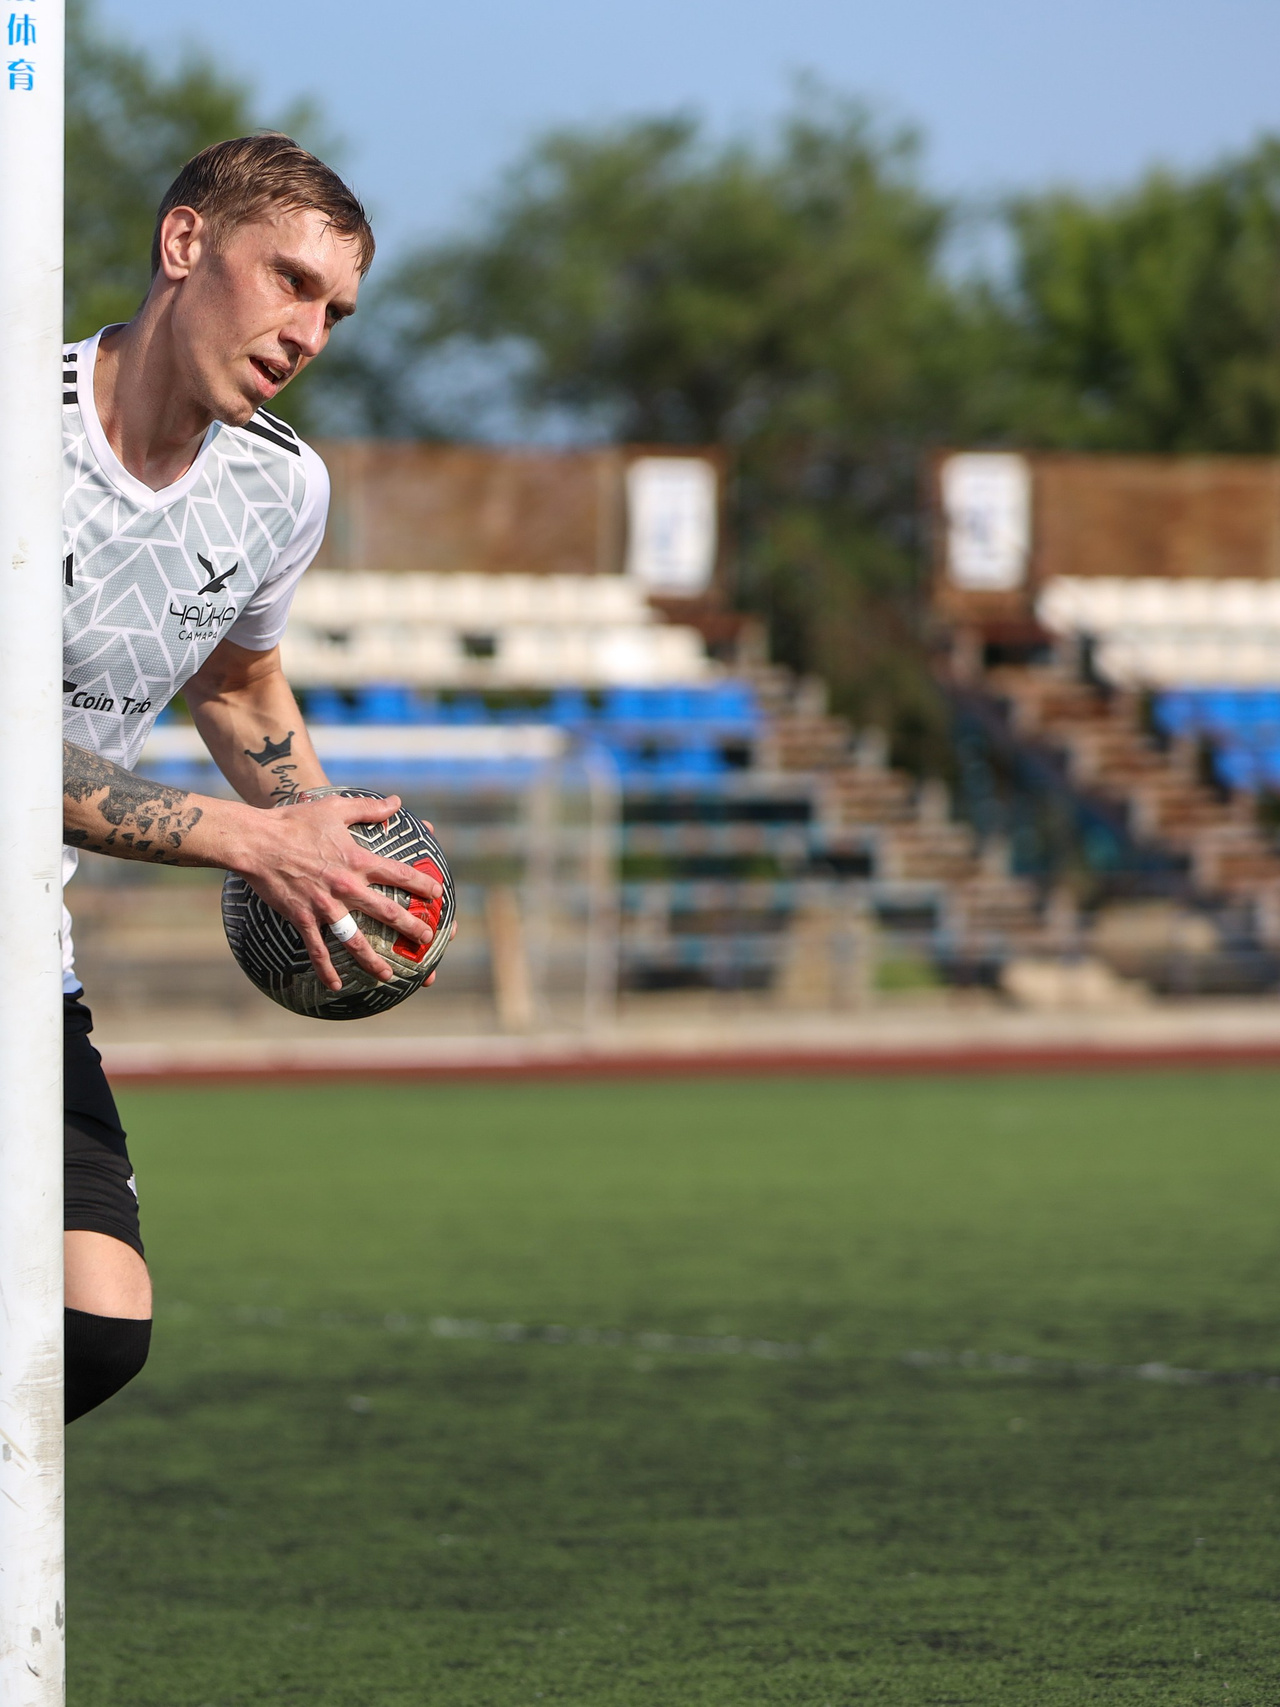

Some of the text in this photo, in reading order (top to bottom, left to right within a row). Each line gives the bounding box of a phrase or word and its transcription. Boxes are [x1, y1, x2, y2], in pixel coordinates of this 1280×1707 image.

[7, 0, 37, 91] 体育
[169, 602, 236, 627] ЧАЙКА
[71, 691, 151, 715] Coin Tab
